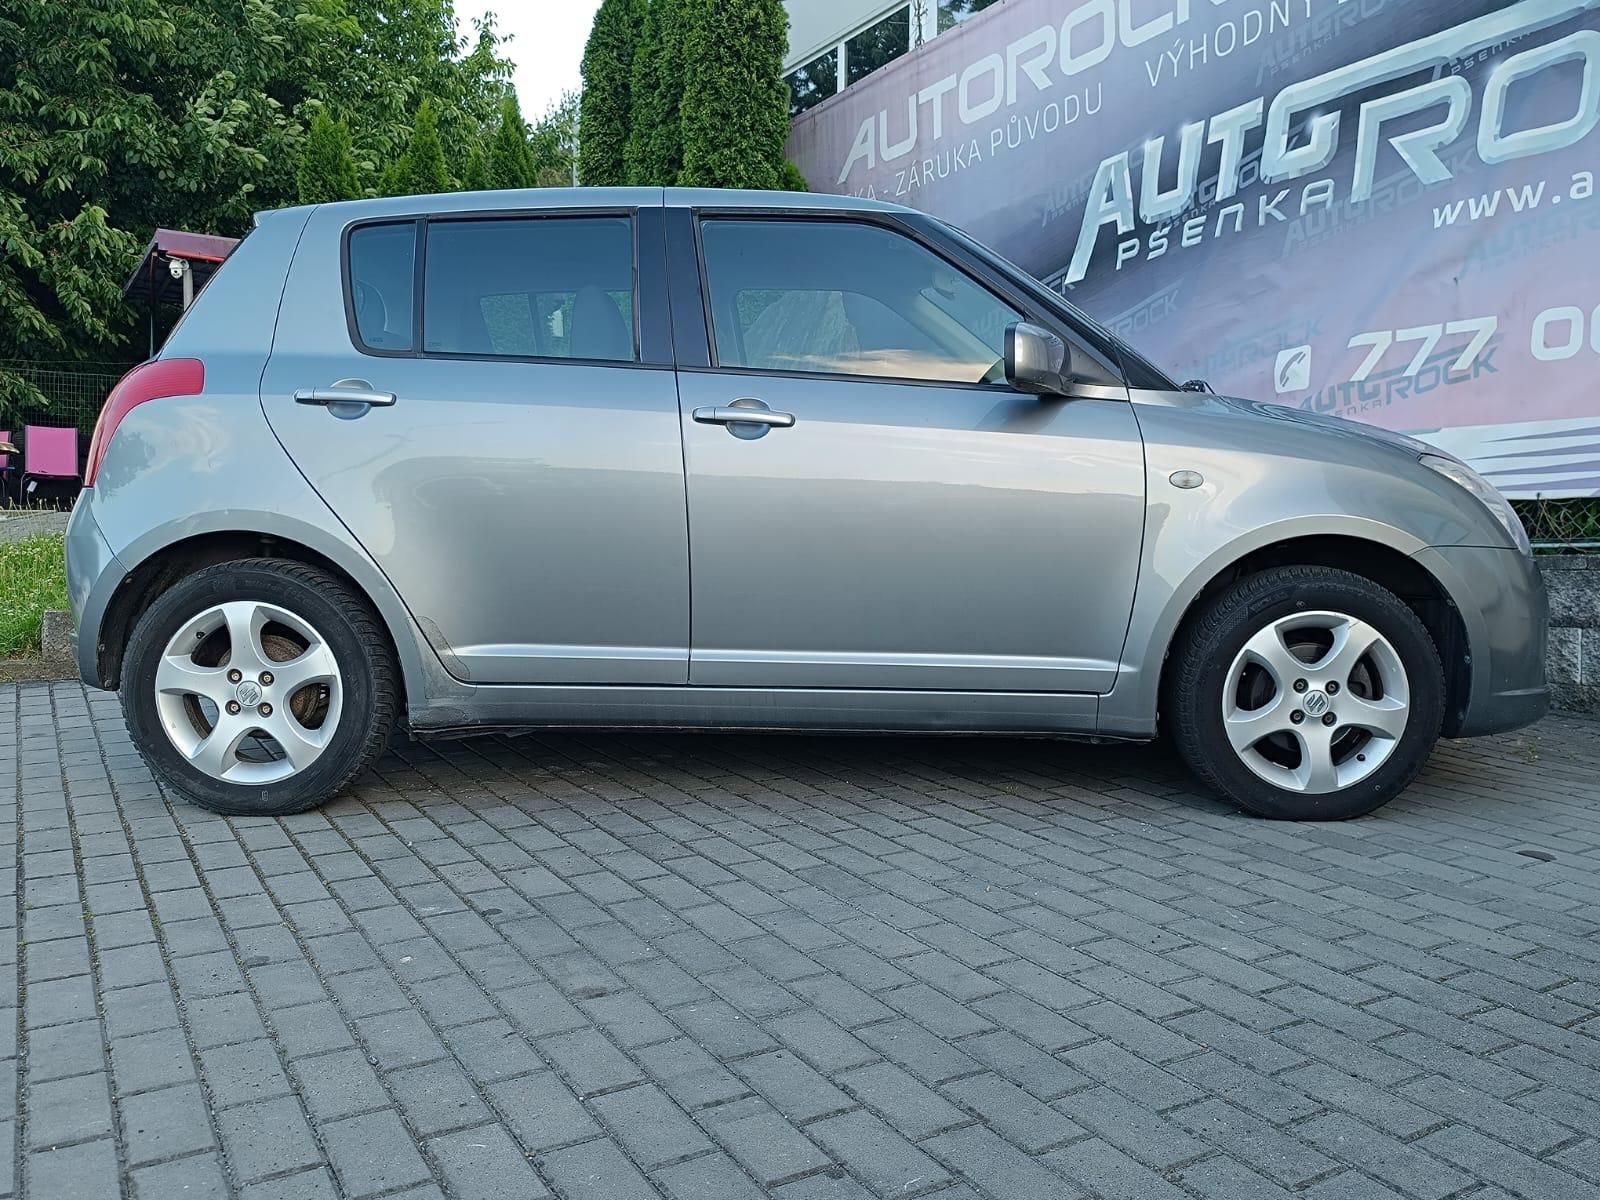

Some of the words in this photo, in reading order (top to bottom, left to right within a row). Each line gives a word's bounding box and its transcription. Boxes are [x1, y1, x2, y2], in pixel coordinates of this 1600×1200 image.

[895, 144, 982, 197] ZÁRUKA
[991, 82, 1103, 157] PŮVODU
[1346, 315, 1499, 383] 777
[1530, 303, 1600, 362] 0
